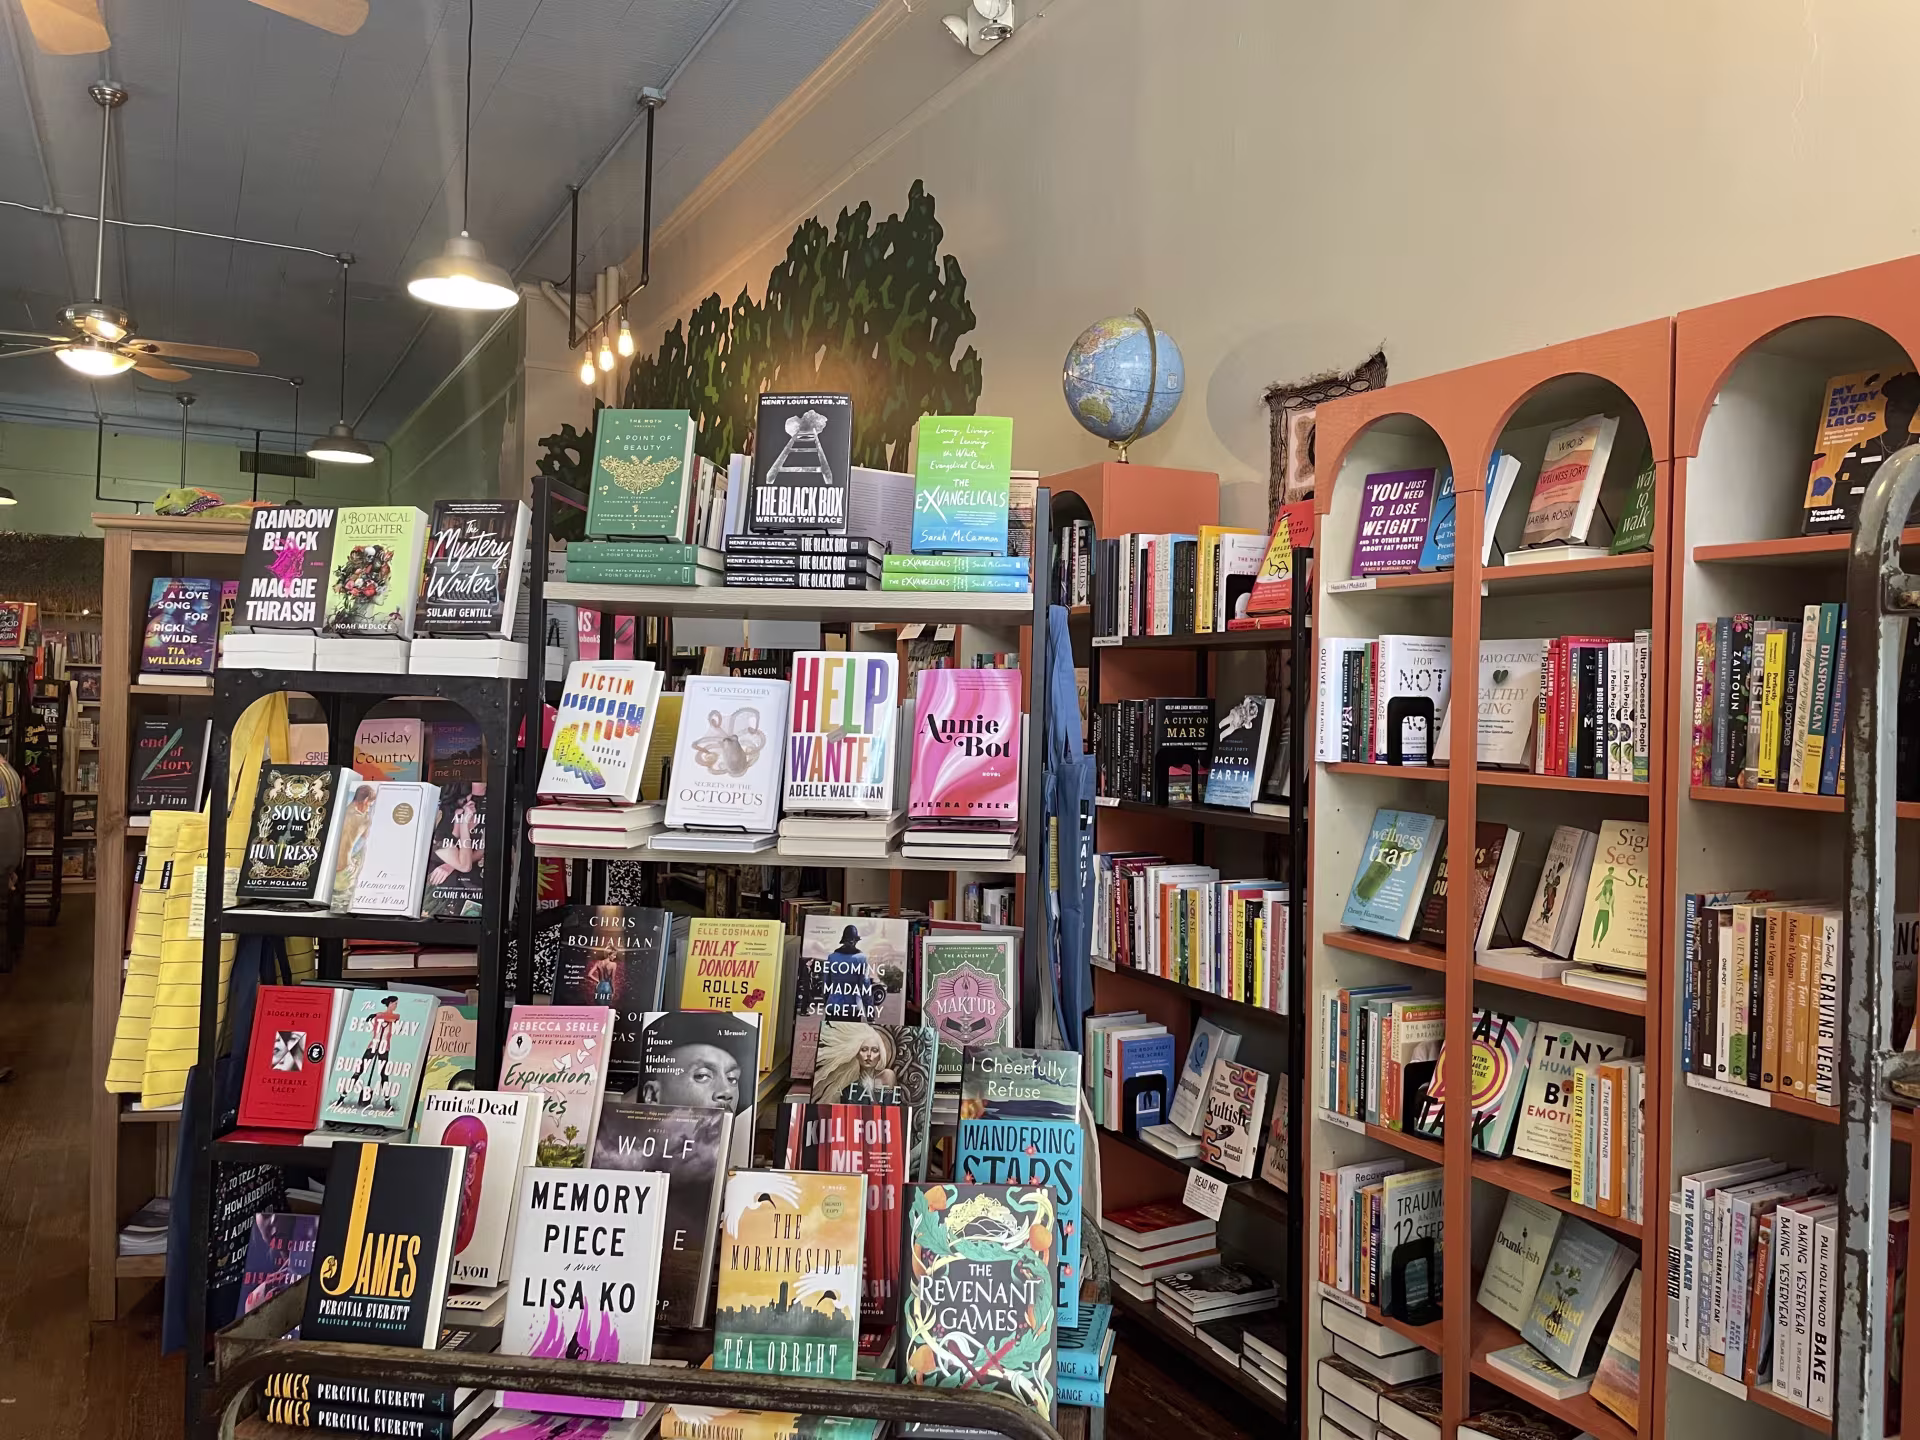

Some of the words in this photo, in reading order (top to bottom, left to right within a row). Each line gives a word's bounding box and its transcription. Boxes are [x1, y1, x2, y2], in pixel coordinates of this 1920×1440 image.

[1830, 390, 1880, 406] EVERY
[1826, 412, 1877, 428] LAGOS
[1828, 404, 1859, 417] DAY
[953, 478, 970, 487] THE
[755, 486, 777, 515] THE
[779, 487, 818, 516] BLACK
[819, 487, 845, 517] BOX
[915, 485, 1007, 525] EXVANGELICALS
[1370, 505, 1385, 517] TO
[1389, 502, 1420, 516] LOSE
[254, 508, 334, 529] RAINBOW
[345, 523, 404, 535] DAUGHTER
[262, 531, 319, 550] BLACK
[434, 528, 510, 570] Mystery
[250, 578, 318, 598] MAGGIE
[427, 566, 497, 598] Writer
[158, 601, 191, 610] SONG
[168, 591, 176, 599] A
[179, 591, 209, 600] LOVE
[184, 612, 208, 621] FOR
[245, 601, 317, 622] THRASH
[427, 607, 456, 617] SULARI
[459, 607, 492, 617] GENTILL
[154, 624, 185, 632] RICKI
[335, 622, 356, 630] NOAH
[358, 622, 393, 630] MEDLOCK
[161, 634, 198, 643] WILDE
[148, 656, 203, 665] WILLIAMS
[168, 647, 185, 655] TIA
[1753, 642, 1766, 676] RICE
[743, 667, 777, 675] PENGUIN
[1540, 656, 1548, 691] Patient
[1696, 656, 1704, 680] INDIA
[581, 672, 635, 695] VICTIM
[1731, 650, 1742, 710] ZAITOUN
[1752, 679, 1762, 694] IS
[1812, 644, 1830, 731] DIASPORICAN
[793, 657, 890, 734] HELP
[1539, 691, 1547, 715] ZERO
[1595, 687, 1604, 717] BODIES
[1695, 681, 1703, 726] EXPRESS
[1595, 717, 1603, 725] ON
[1749, 698, 1760, 734] LIFE
[360, 731, 412, 744] Holiday
[918, 713, 999, 743] Annie
[1167, 728, 1206, 738] MARS
[1595, 725, 1603, 738] THE
[953, 735, 1011, 758] Bot
[1595, 738, 1603, 759] LINE
[155, 759, 194, 771] story
[355, 752, 416, 764] Country
[791, 735, 886, 784] WANTED
[1214, 756, 1235, 765] BACK
[1237, 757, 1249, 765] TO
[1210, 769, 1249, 782] EARTH
[679, 788, 763, 806] OCTOPUS
[271, 805, 312, 821] SONG
[1368, 844, 1413, 872] trap
[1604, 846, 1636, 867] See
[589, 915, 637, 928] CHRIS
[697, 927, 719, 935] ELLE
[721, 928, 770, 936] COSIMANO
[567, 935, 654, 949] BOHJALIAN
[690, 939, 740, 957] FINLAY
[697, 958, 761, 978] DONOVAN
[813, 960, 886, 976] BECOMING
[1734, 937, 1744, 998] VIETNAMESE
[702, 979, 750, 994] ROLLS
[822, 982, 873, 996] MADAM
[708, 996, 732, 1009] THE
[808, 1002, 885, 1018] SECRETARY
[935, 996, 997, 1017] MAKTUB
[1821, 973, 1836, 1039] CRAVING
[441, 1010, 454, 1021] The
[349, 1017, 382, 1032] BEST
[391, 1021, 419, 1037] WAY
[439, 1023, 462, 1038] Tree
[512, 1021, 561, 1032] REBECCA
[565, 1022, 600, 1032] SERLE
[1732, 1000, 1743, 1064] VEGETARIAN
[371, 1038, 387, 1054] TO
[434, 1040, 472, 1054] Doctor
[335, 1057, 371, 1074] BURY
[377, 1058, 413, 1076] YOUR
[646, 1055, 676, 1064] Hidden
[971, 1058, 975, 1072] I
[980, 1058, 1068, 1082] Cheerfully
[1816, 1042, 1832, 1094] VEGAN
[503, 1063, 592, 1090] Expiration
[644, 1065, 685, 1076] Meanings
[336, 1077, 401, 1102] HUSBAND
[987, 1081, 1041, 1099] Refuse
[1574, 1071, 1584, 1094] EMILY
[326, 1100, 358, 1116] Alexia
[361, 1105, 395, 1118] Casale
[426, 1094, 463, 1113] Fruit
[477, 1099, 519, 1117] Dead
[1208, 1097, 1247, 1128] Cultish
[1573, 1095, 1583, 1117] OSTER
[805, 1117, 845, 1146] KILL
[853, 1117, 892, 1144] FOR
[964, 1125, 1076, 1155] WANDERING
[1573, 1119, 1583, 1157] EXPECTING
[618, 1135, 696, 1160] WOLF
[1571, 1159, 1580, 1186] BETTER
[1194, 1175, 1208, 1189] READ
[1207, 1181, 1219, 1195] ME?
[531, 1180, 651, 1215] MEMORY
[320, 1142, 421, 1298] JAMES
[774, 1213, 803, 1240] THE
[543, 1224, 627, 1257] PIECE
[1496, 1230, 1541, 1265] Drunk-ish
[1779, 1216, 1791, 1258] BAKING
[1819, 1234, 1829, 1261] PAUL
[453, 1260, 490, 1280] Lyon
[731, 1244, 842, 1276] MORNINGSIDE
[968, 1263, 992, 1277] THE
[1667, 1245, 1681, 1300] FERMENTER
[522, 1277, 586, 1310] LISA
[599, 1282, 636, 1313] KO
[920, 1275, 1040, 1308] REVENANT
[1777, 1262, 1790, 1328] YESTERYEAR
[1818, 1262, 1828, 1328] HOLLYWOOD
[318, 1299, 364, 1318] PERCIVAL
[368, 1303, 410, 1321] EVERETT
[940, 1305, 1019, 1335] GAMES
[724, 1335, 755, 1371] TÉA
[767, 1340, 838, 1374] OBREHT
[1812, 1331, 1827, 1384] BAKE
[265, 1373, 310, 1400] JAMES
[318, 1383, 370, 1404] PERCIVAL
[374, 1388, 425, 1409] EVERETT
